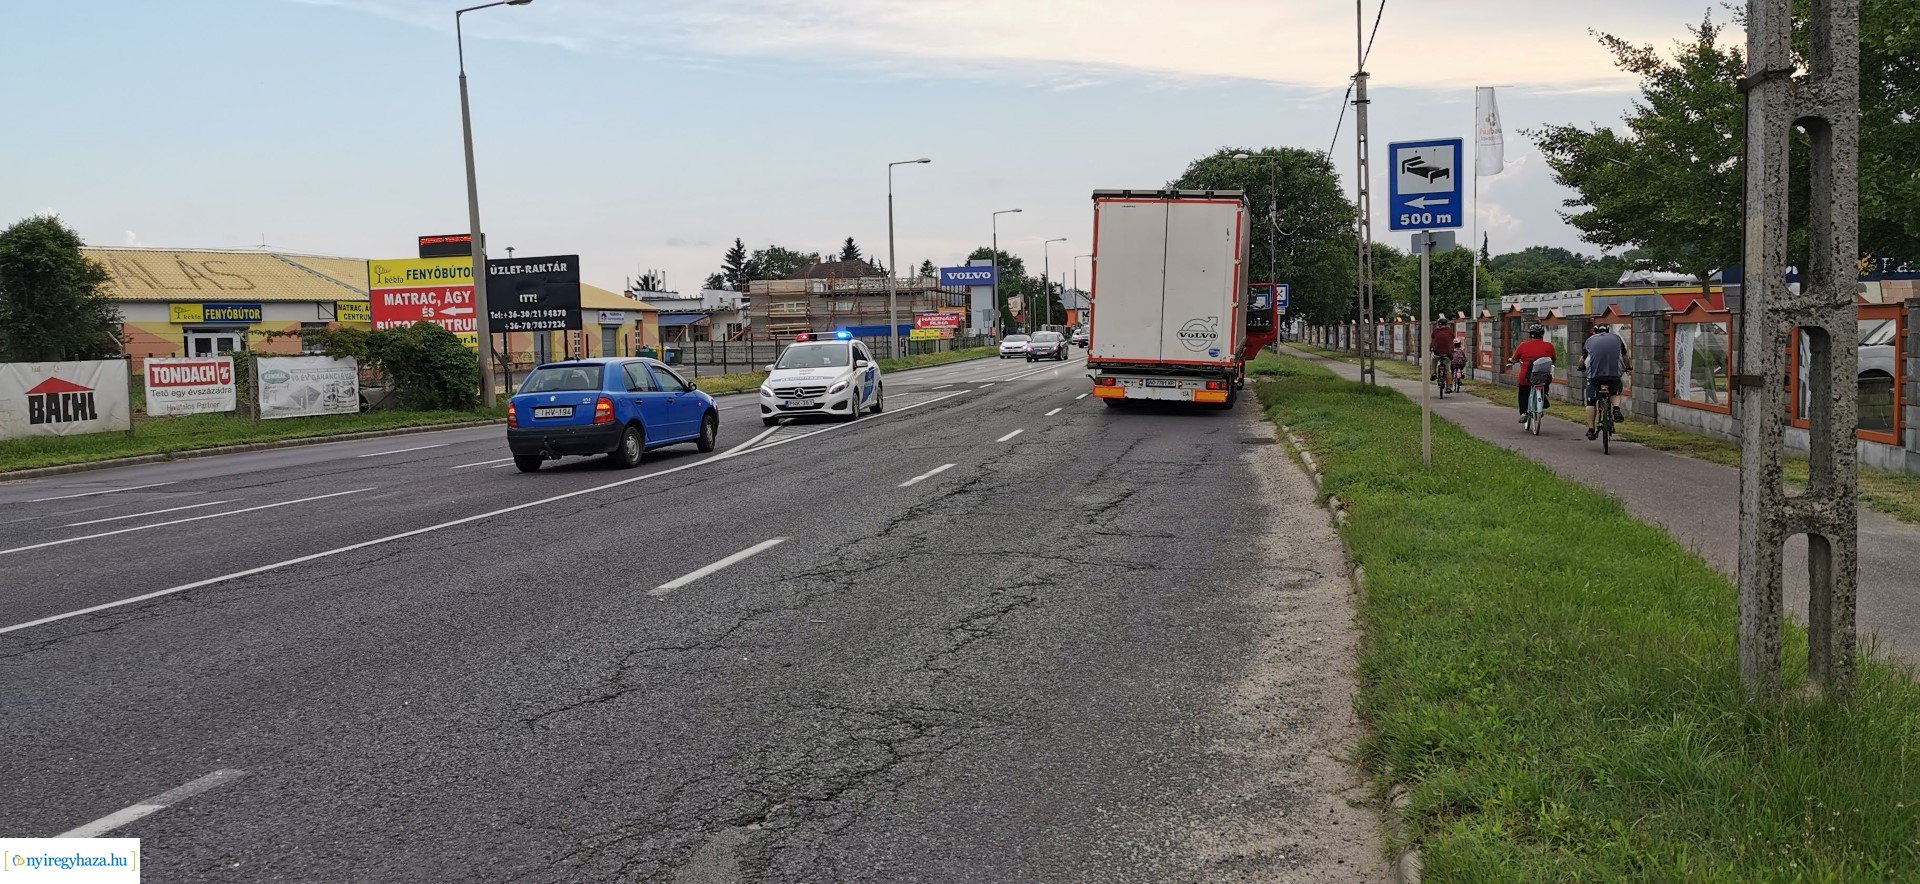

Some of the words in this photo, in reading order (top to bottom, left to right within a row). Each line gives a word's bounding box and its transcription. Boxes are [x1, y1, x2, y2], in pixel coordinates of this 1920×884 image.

[1400, 212, 1432, 225] 500
[1436, 213, 1452, 223] m
[406, 265, 474, 280] FENYŐBÚTO
[490, 261, 568, 275] ÜZLET-RAKTÁR
[946, 271, 992, 280] VOLVO
[384, 292, 441, 307] MATRAC,
[444, 288, 471, 304] ÁGY
[519, 293, 538, 303] ITT!
[205, 307, 261, 319] FENYŐBÚTOR
[422, 305, 435, 317] ÉS
[1179, 331, 1217, 339] VOLVO
[151, 365, 216, 384] TONDACH
[151, 389, 169, 397] Tető
[171, 390, 186, 398] egy
[28, 392, 98, 424] BACHL
